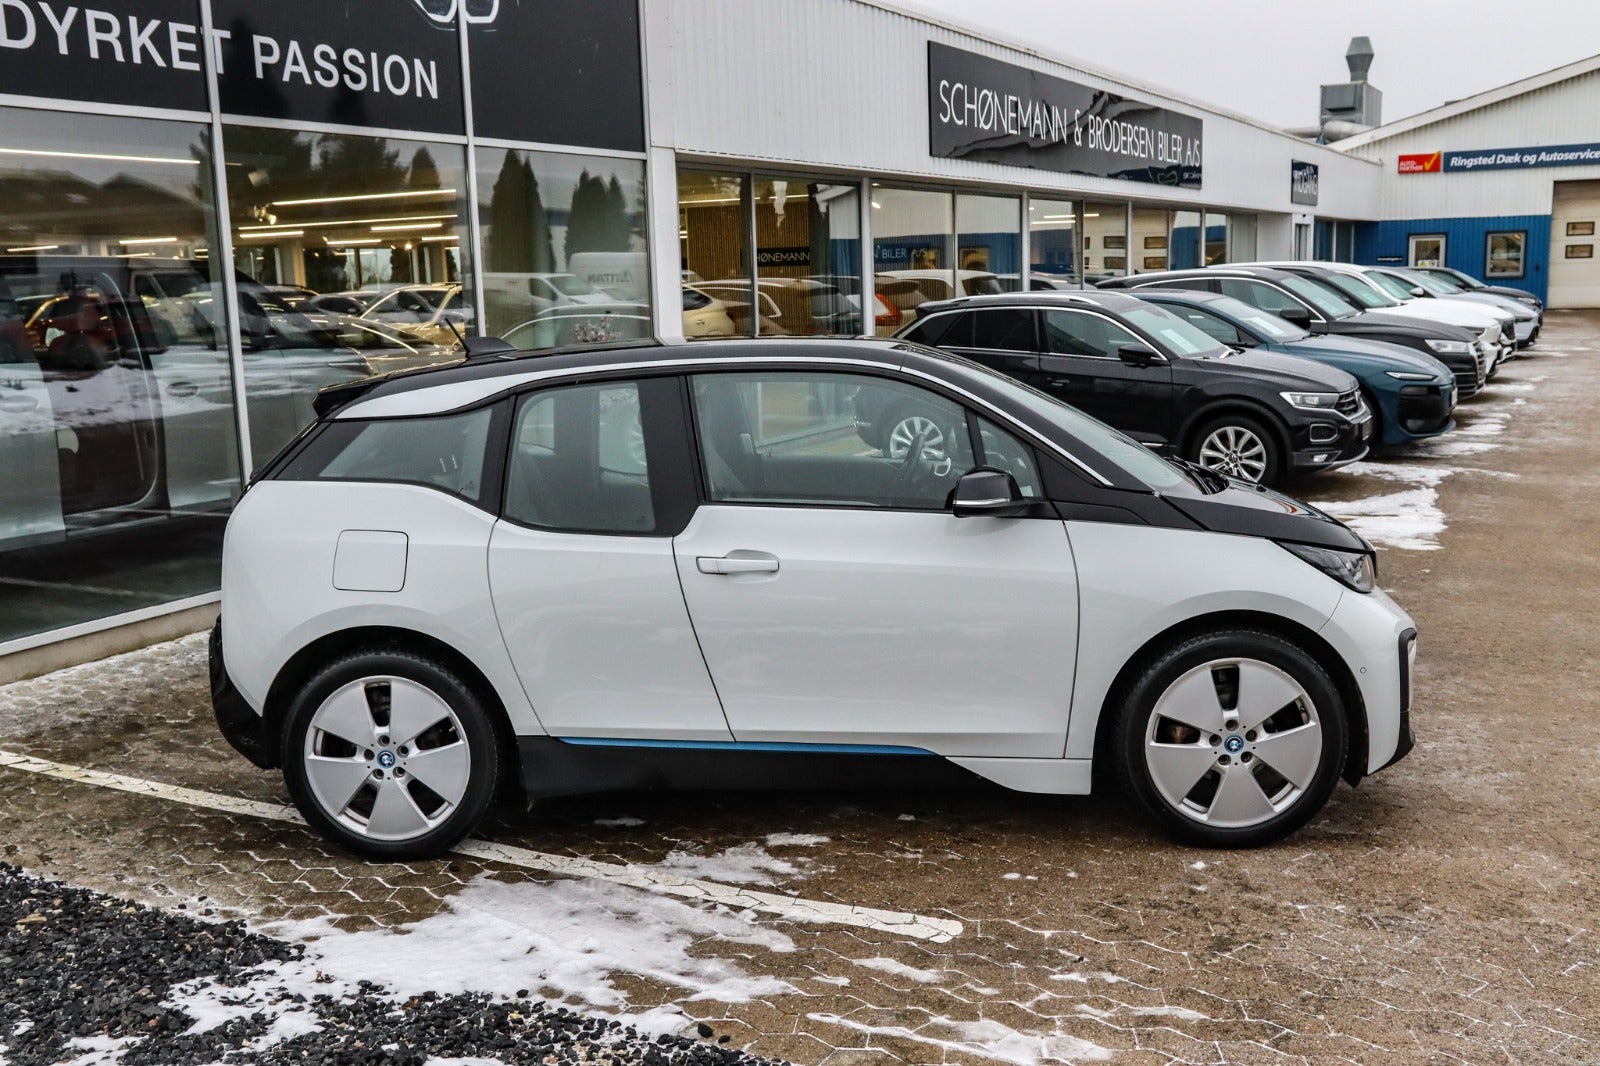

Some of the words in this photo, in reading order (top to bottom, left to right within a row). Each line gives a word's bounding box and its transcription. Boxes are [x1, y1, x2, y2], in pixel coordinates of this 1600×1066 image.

[0, 0, 231, 75] DYRKET
[252, 34, 438, 99] PASSION
[939, 79, 1067, 144] SCHØNEMANN
[1073, 109, 1083, 147] &
[1088, 114, 1154, 160] BRODERSEN
[1158, 131, 1183, 164] BILER
[1185, 137, 1200, 167] A/S
[1450, 154, 1496, 168] Ringsted
[1496, 153, 1521, 164] Dæk
[1523, 154, 1536, 165] og
[1537, 149, 1600, 162] Autoservice
[882, 248, 908, 259] BILER
